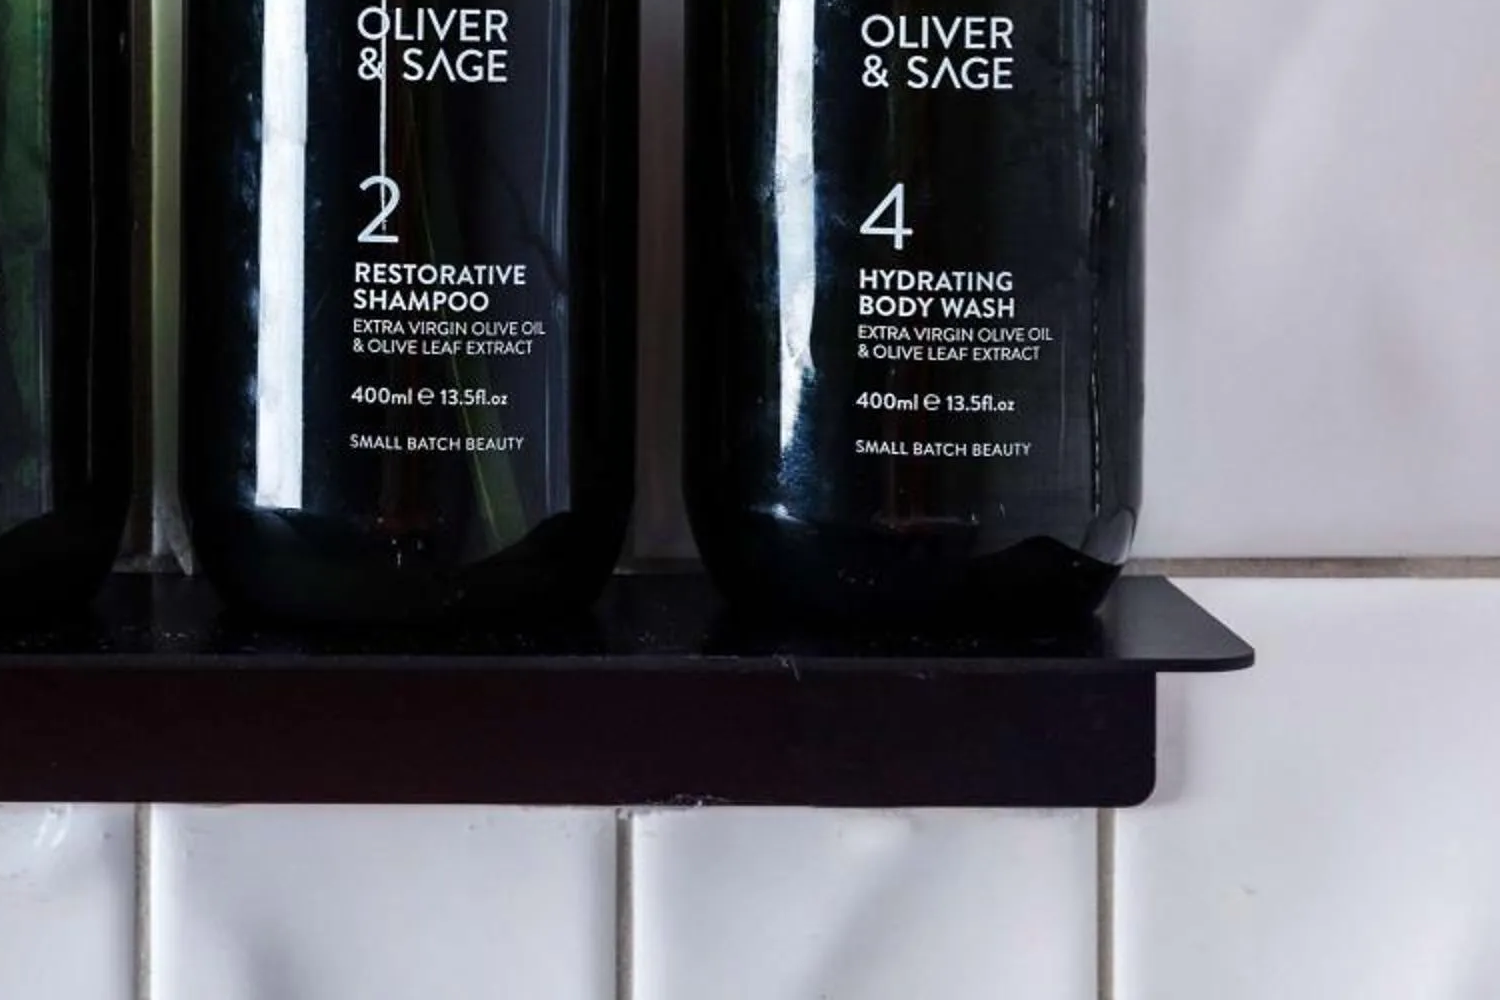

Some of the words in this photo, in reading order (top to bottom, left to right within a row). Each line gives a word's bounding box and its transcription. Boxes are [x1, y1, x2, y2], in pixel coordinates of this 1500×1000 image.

[357, 6, 509, 42] OLIVER
[860, 14, 1014, 50] OLIVER
[358, 48, 384, 82] &
[403, 49, 508, 83] SAGE
[861, 54, 889, 88] &
[907, 55, 1014, 90] SAGE
[357, 175, 400, 243] 2
[859, 182, 914, 250] 4
[354, 263, 526, 285] RESTORATIVE
[860, 269, 1013, 292] HYDRATING
[353, 289, 489, 312] SHAMPOO
[860, 295, 933, 318] BODY
[941, 296, 1015, 318] WASH
[353, 319, 404, 335] EXTRA
[409, 321, 467, 336] VIRGIN
[471, 321, 519, 336] OLIVE
[521, 321, 546, 336] OIL
[857, 325, 910, 341] EXTRA
[914, 326, 973, 342] VIRGIN
[978, 327, 1025, 342] OLIVE
[1028, 327, 1053, 342] OIL
[353, 338, 364, 353] &
[367, 339, 417, 355] OLIVE
[422, 339, 461, 355] LEAF
[467, 339, 533, 356] EXTRACT
[857, 343, 870, 359] &
[872, 344, 923, 360] OLIVE
[928, 345, 968, 361] LEAF
[973, 345, 1041, 361] EXTRACT
[351, 385, 413, 405] 400ml
[440, 389, 508, 407] 13.5fl.oz
[856, 391, 918, 411] 400ml
[946, 394, 1015, 412] 13.5fl.oz
[350, 433, 402, 450] SMALL
[407, 435, 460, 451] BATCH
[465, 436, 525, 451] BEAUTY
[855, 439, 908, 456] SMALL
[913, 440, 967, 457] BATCH
[971, 442, 1032, 457] BEAUTY
